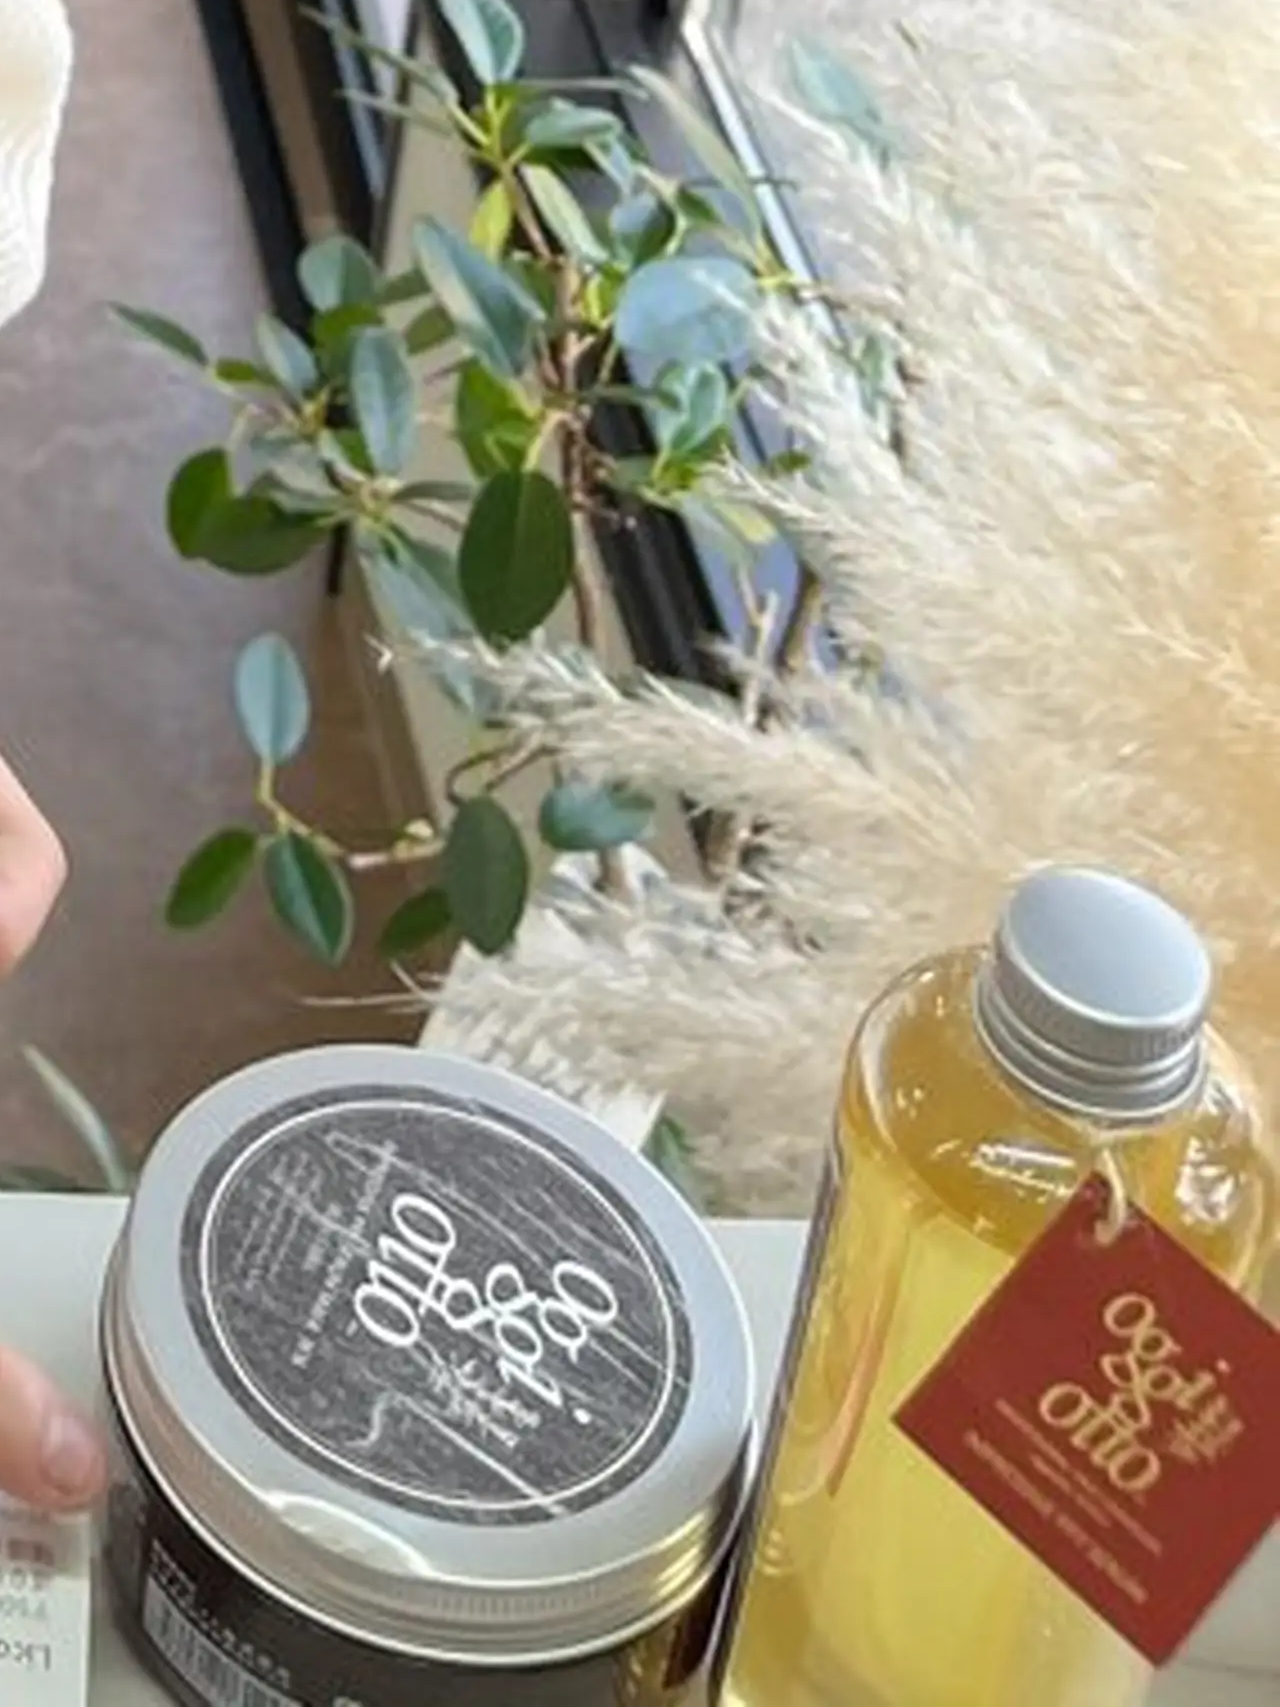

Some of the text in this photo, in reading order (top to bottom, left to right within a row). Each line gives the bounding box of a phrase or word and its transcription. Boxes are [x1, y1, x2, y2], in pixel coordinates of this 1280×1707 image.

[354, 1192, 456, 1347] otto
[439, 1260, 619, 1425] oggi
[1100, 1293, 1230, 1429] oggi
[1040, 1383, 1160, 1491] otto
